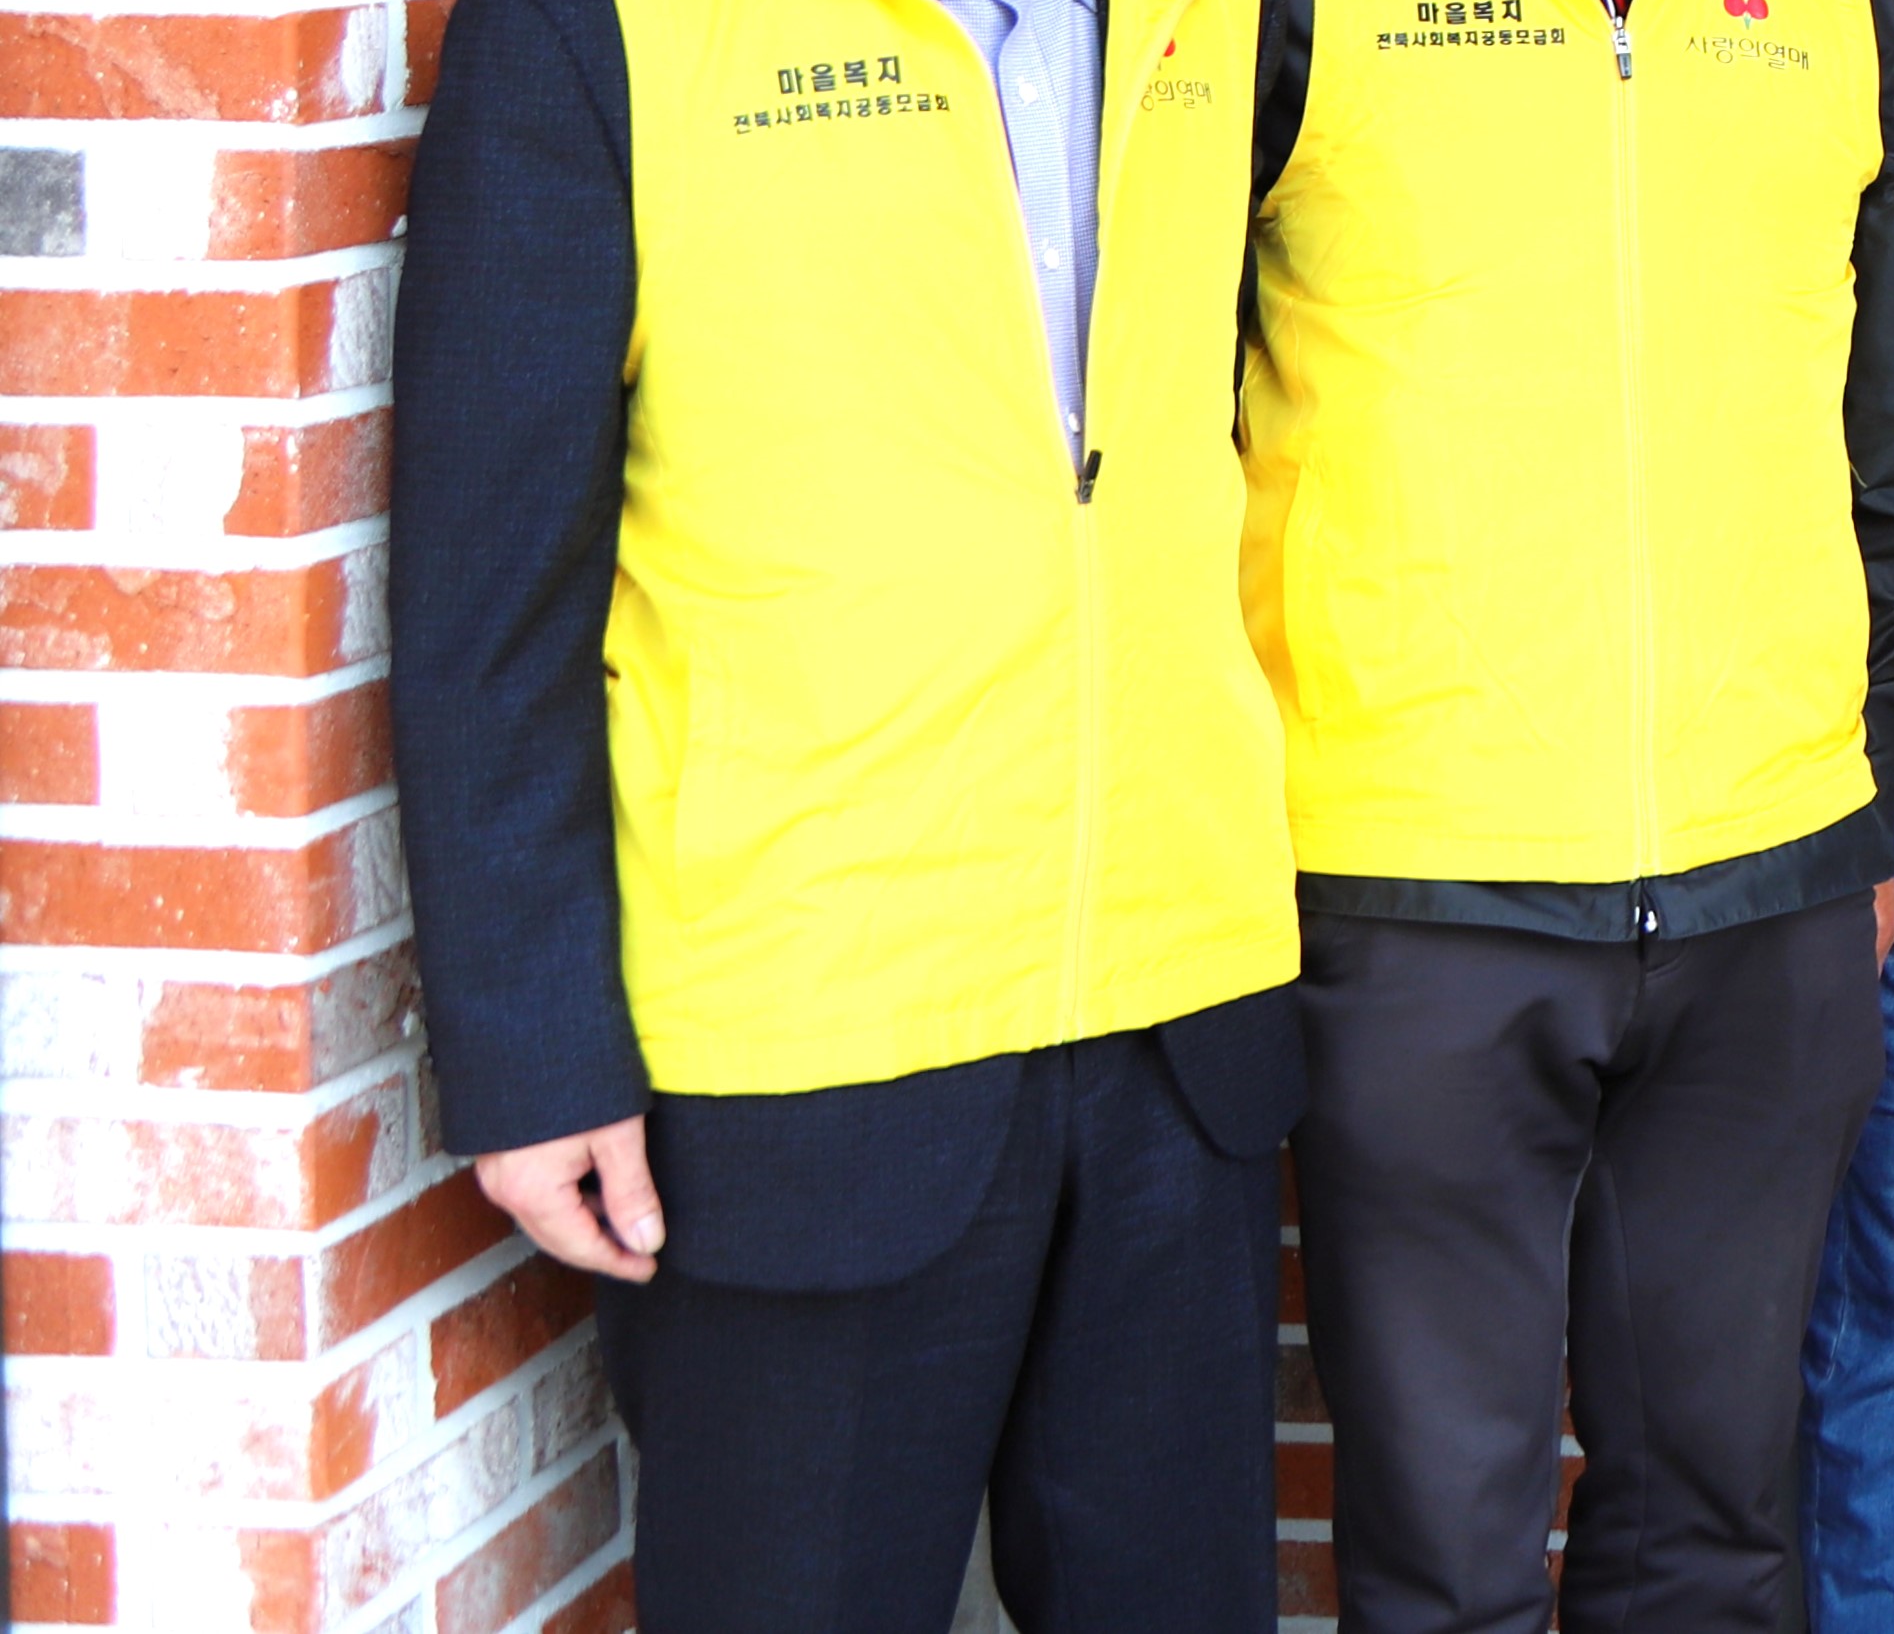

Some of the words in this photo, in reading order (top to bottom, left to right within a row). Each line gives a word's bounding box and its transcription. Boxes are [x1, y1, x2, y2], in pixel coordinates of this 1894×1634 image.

[1375, 27, 1566, 53] 전북사회복지공동모금회
[1684, 34, 1810, 72] 사랑의열매
[777, 54, 903, 96] 마을복지
[732, 93, 952, 136] 전북사회복지공동모금회
